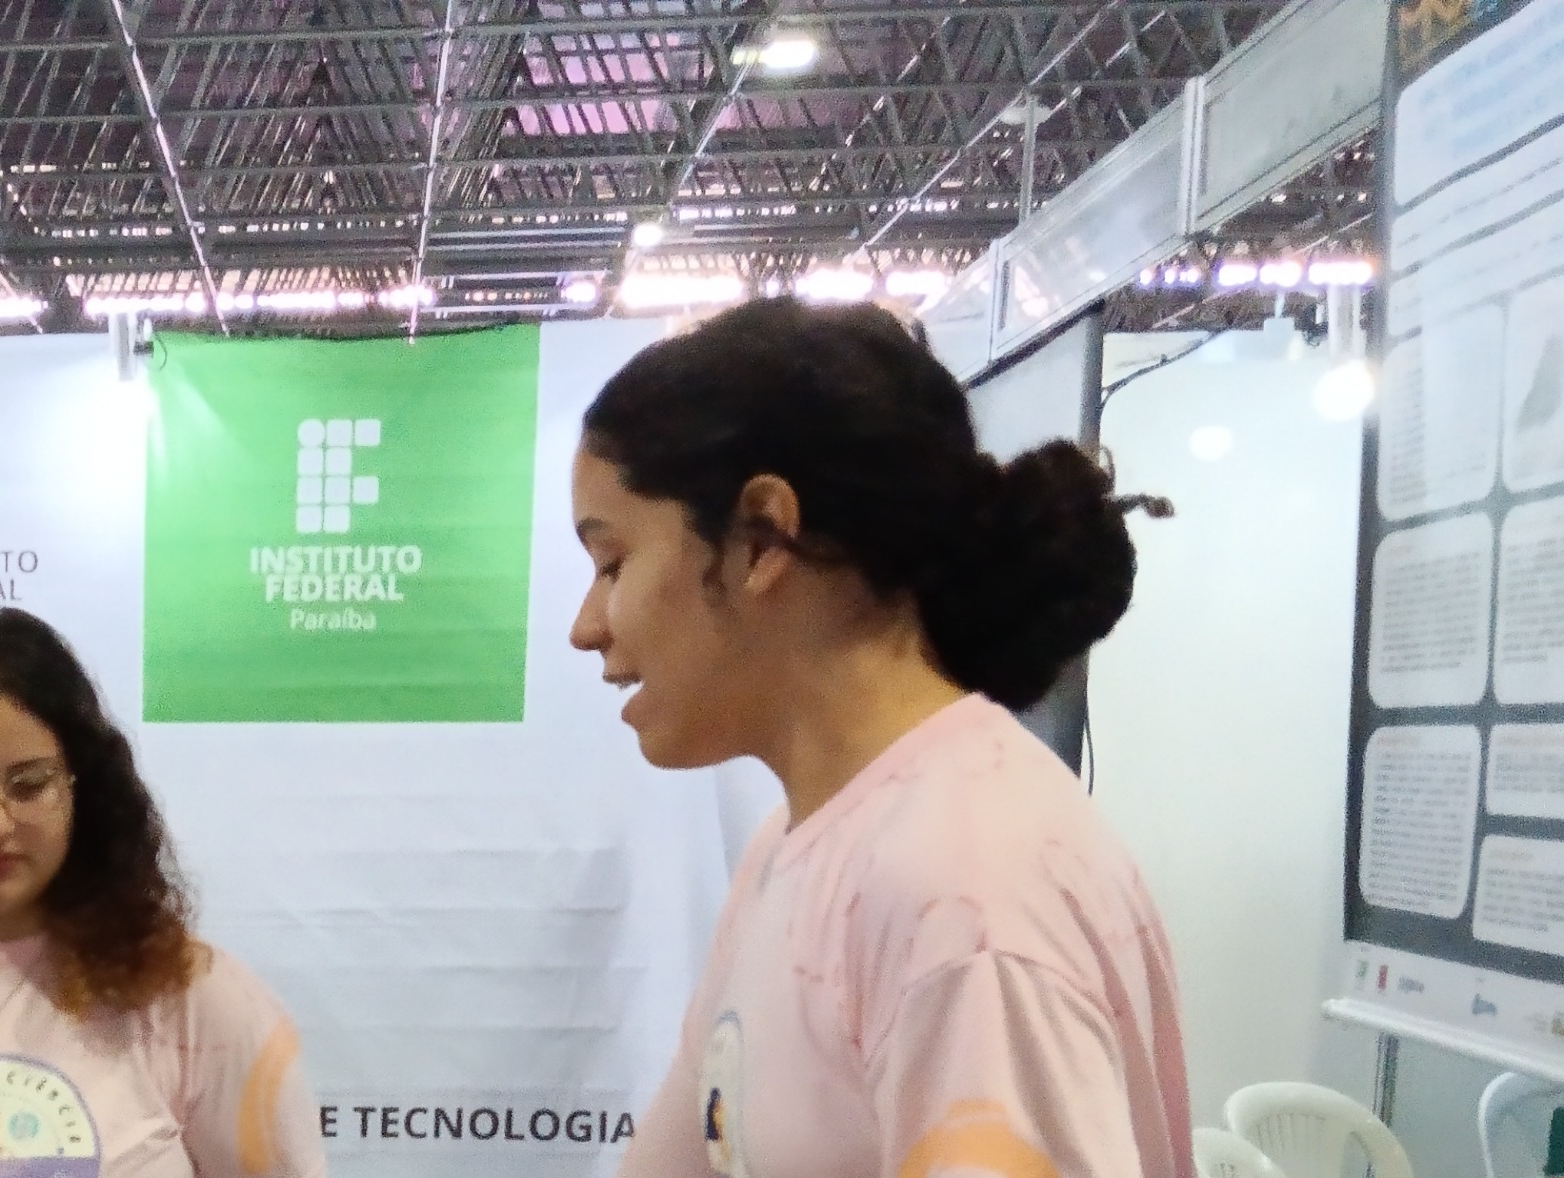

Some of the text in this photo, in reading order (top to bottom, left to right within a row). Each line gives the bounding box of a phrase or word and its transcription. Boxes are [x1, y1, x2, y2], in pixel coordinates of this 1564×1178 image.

[250, 544, 422, 575] INSTITUTO
[265, 572, 405, 604] FEDERAL
[320, 1105, 636, 1144] E TECNOLOGIA
